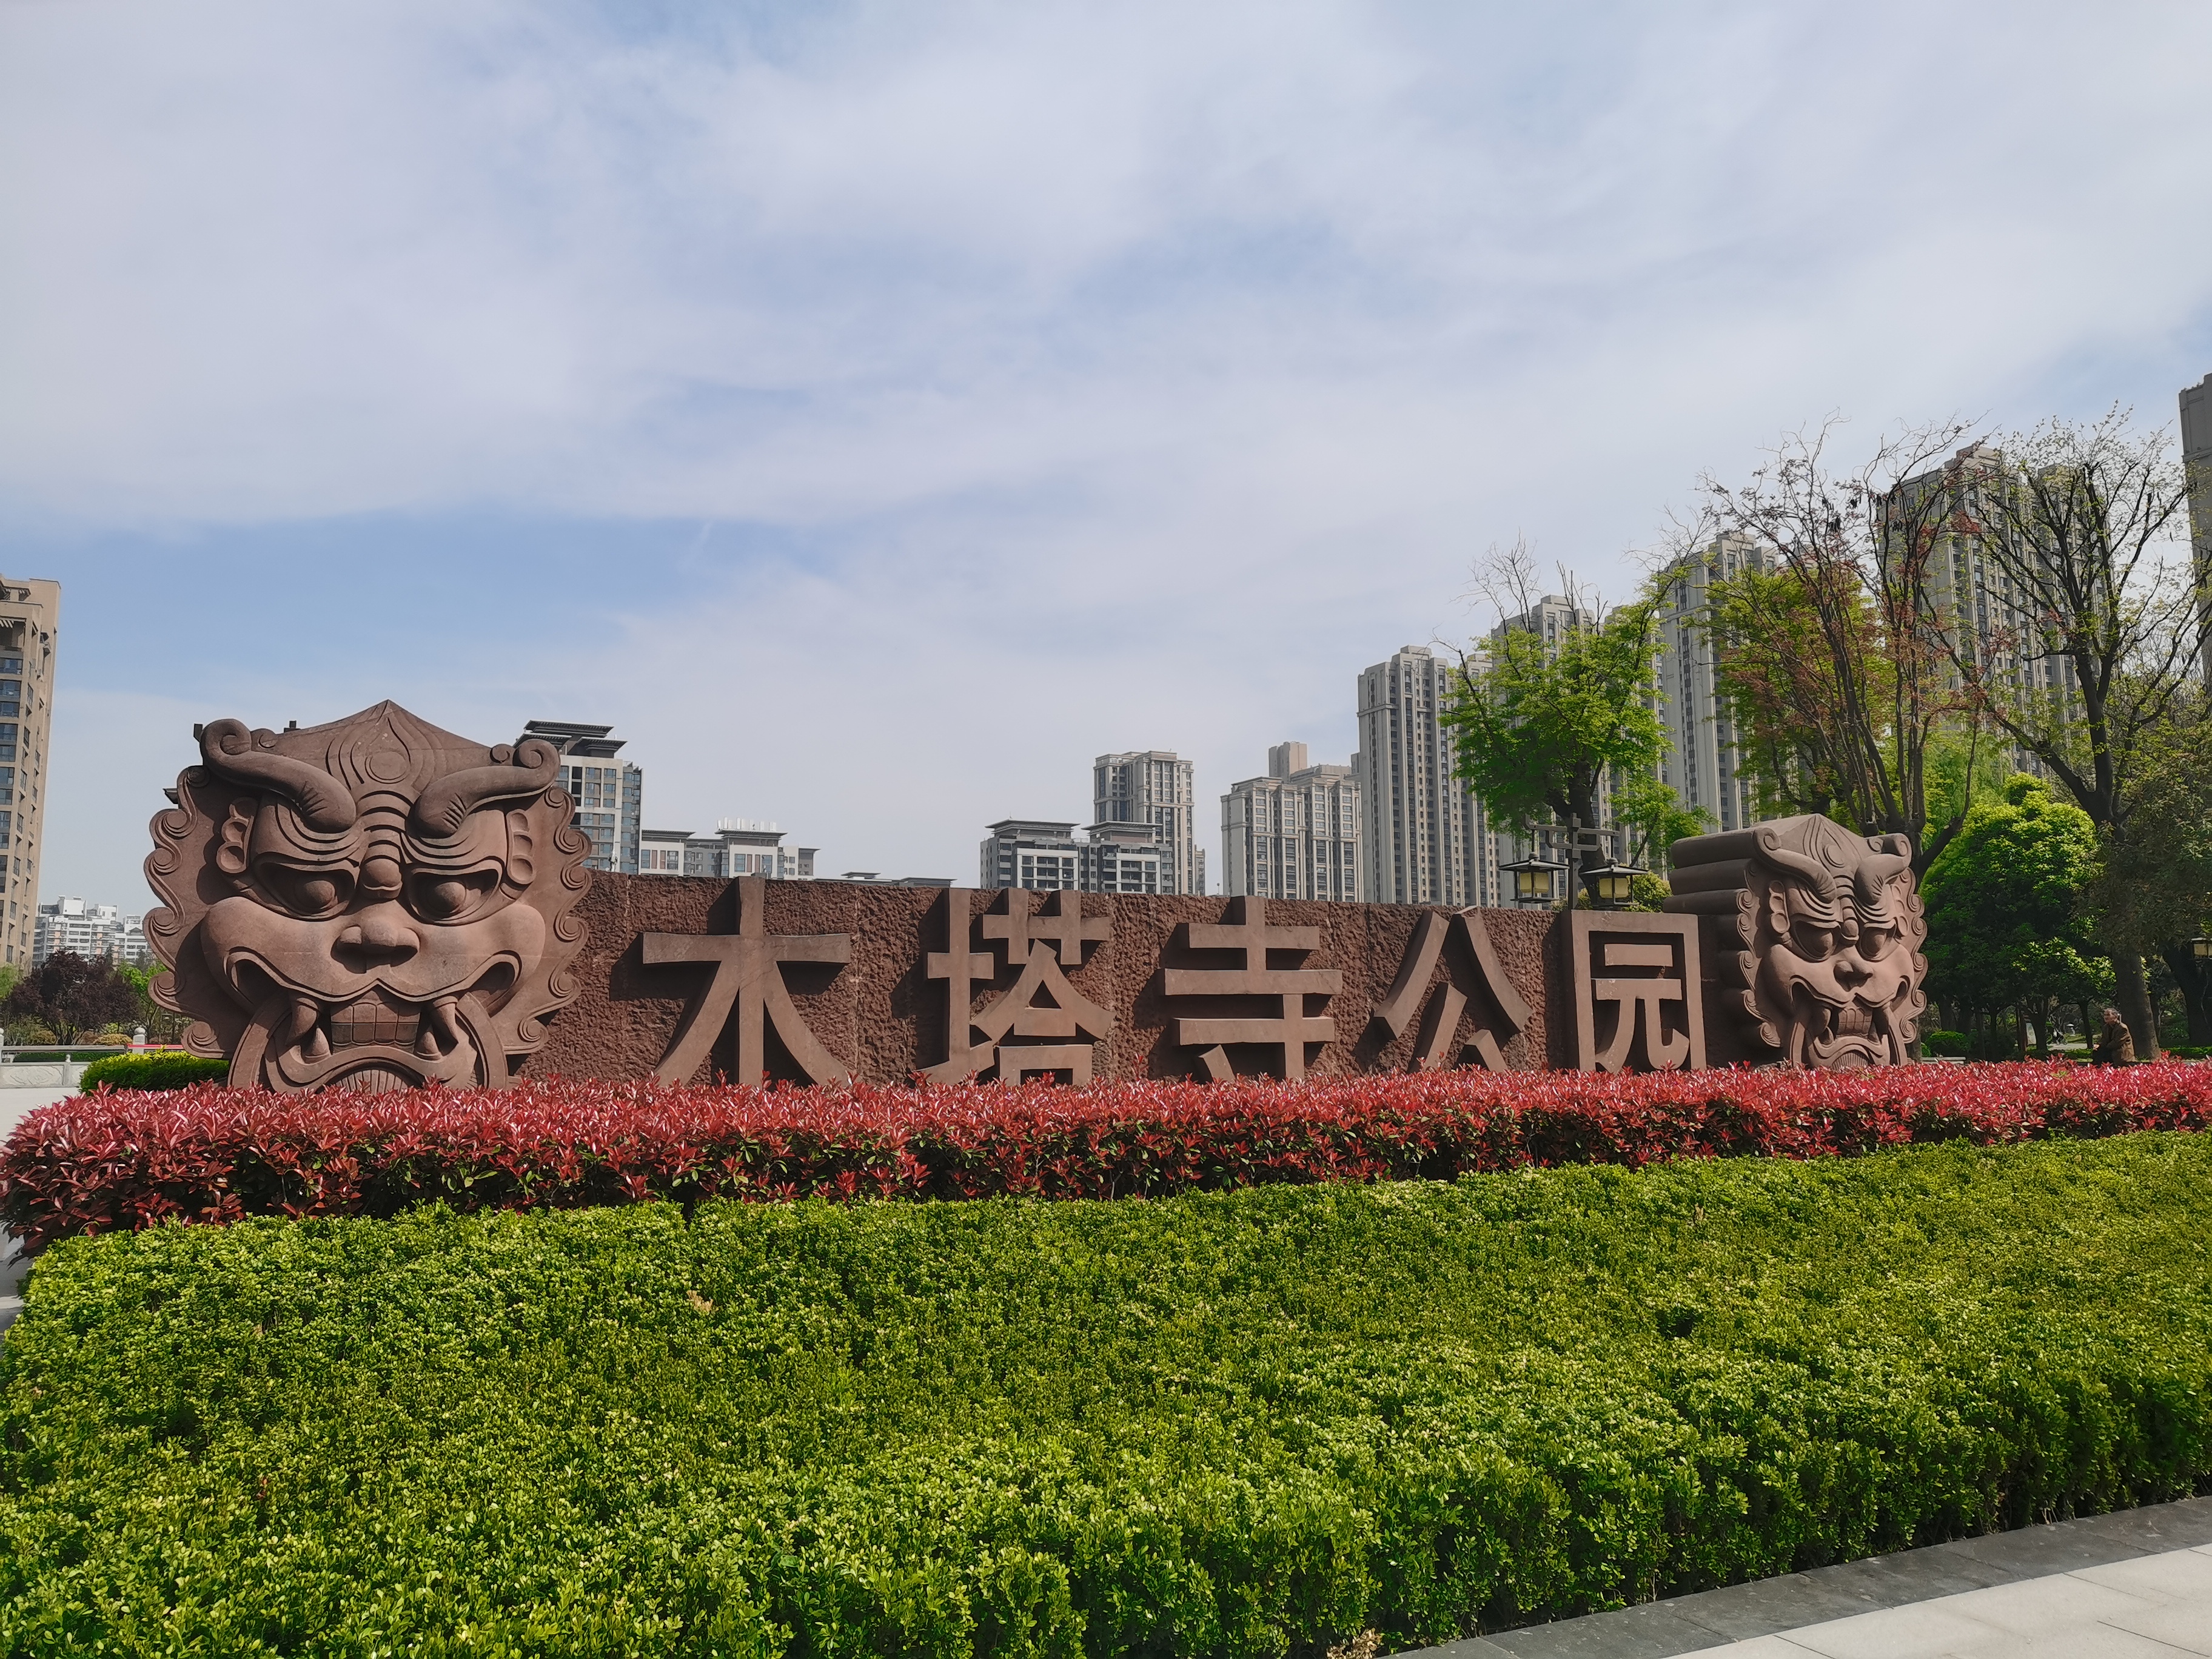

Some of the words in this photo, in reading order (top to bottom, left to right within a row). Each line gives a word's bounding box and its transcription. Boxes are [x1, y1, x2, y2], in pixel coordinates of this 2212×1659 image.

[642, 877, 1706, 1087] 木塔寺公园
